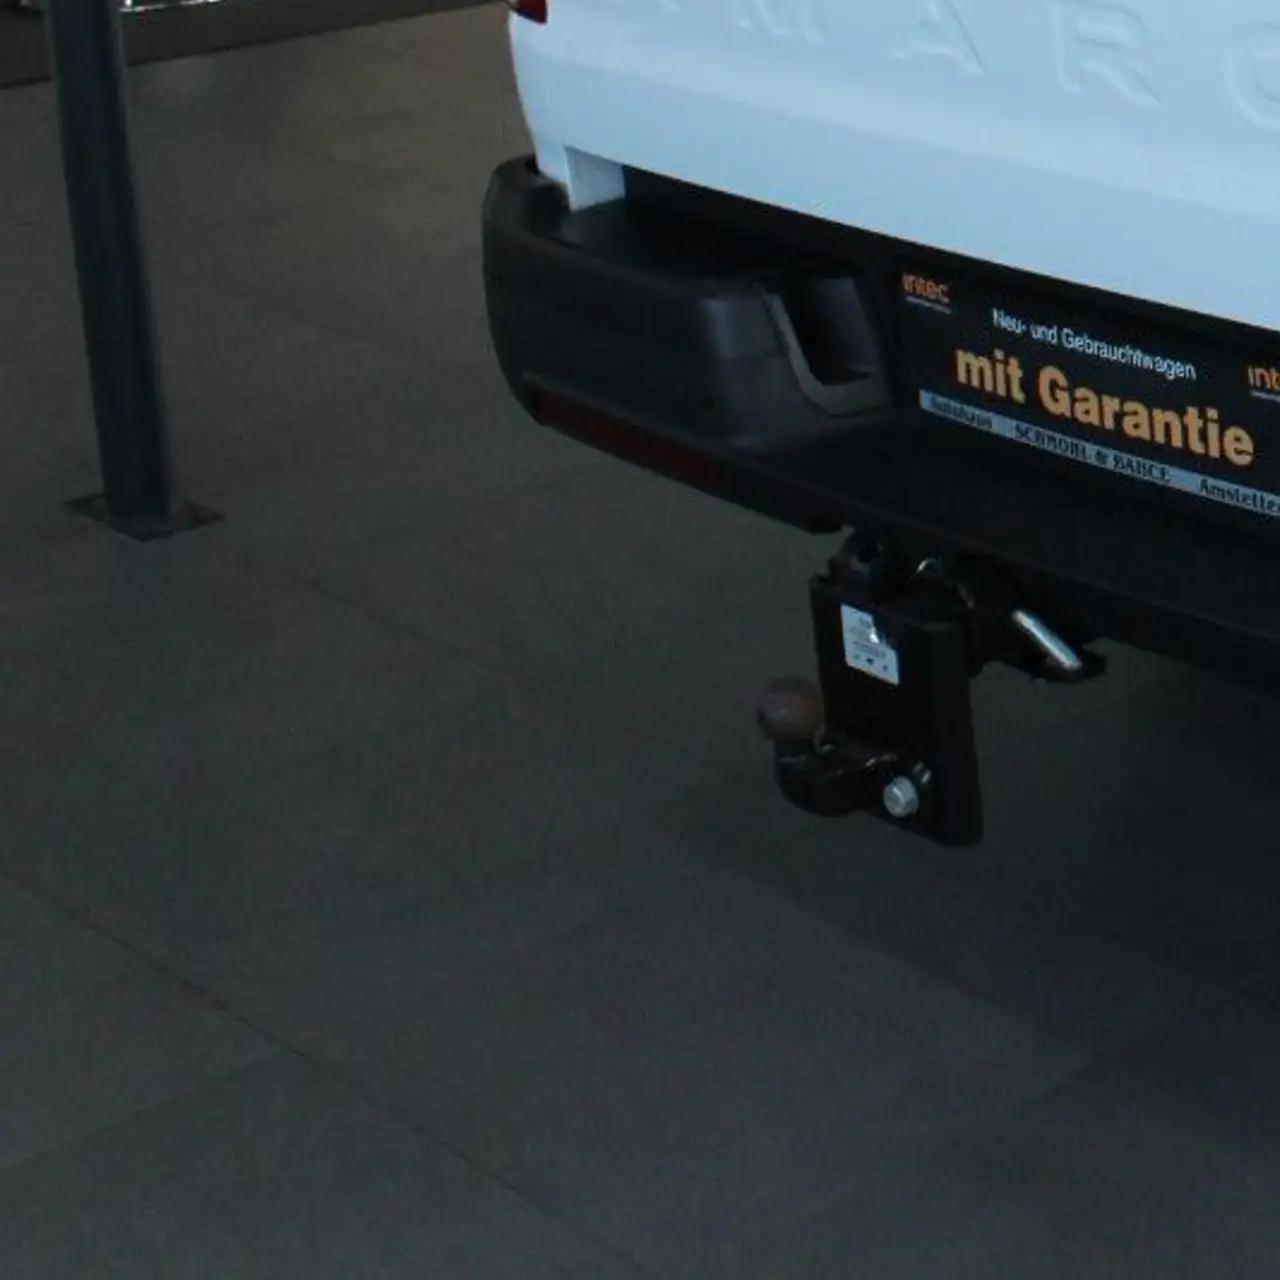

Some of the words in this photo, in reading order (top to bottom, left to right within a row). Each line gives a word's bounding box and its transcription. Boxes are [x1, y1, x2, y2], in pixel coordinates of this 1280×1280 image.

[902, 271, 950, 304] intec
[992, 308, 1028, 336] Neu-
[1030, 322, 1058, 346] und
[1061, 327, 1197, 381] Gebrauchtwagen
[956, 347, 1027, 404] mit
[1039, 365, 1255, 468] Garantie
